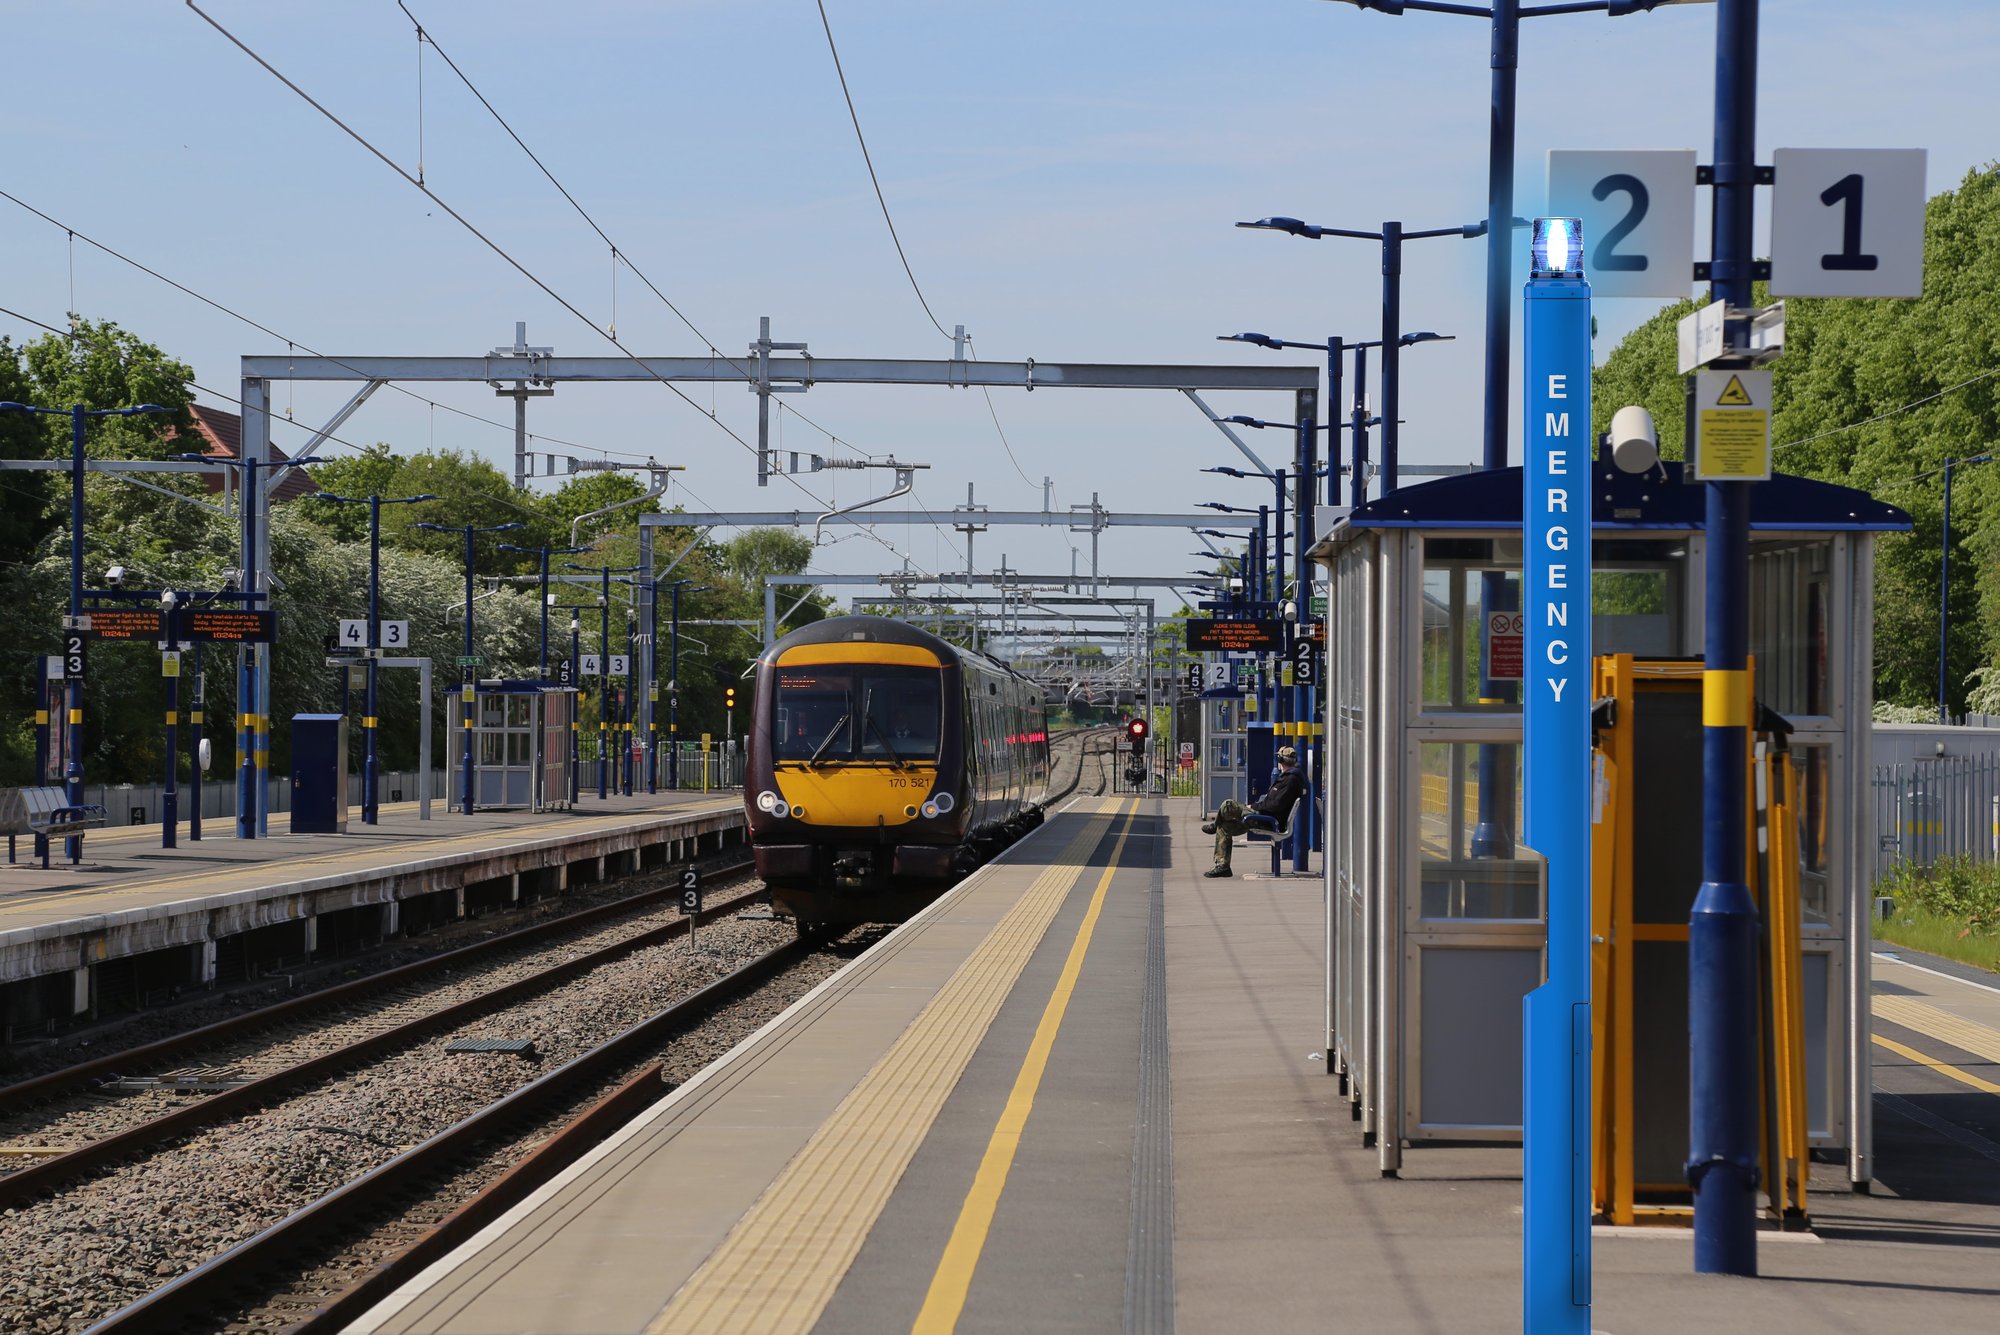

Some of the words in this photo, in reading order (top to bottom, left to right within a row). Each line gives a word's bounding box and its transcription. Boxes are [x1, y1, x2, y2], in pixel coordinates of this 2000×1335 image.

[1592, 174, 1649, 271] 2
[1820, 174, 1878, 271] 1
[1545, 375, 1569, 703] EMERGENCY
[347, 624, 360, 642] 4
[389, 625, 400, 643] 3
[69, 638, 81, 653] 2
[1299, 643, 1310, 659] 2
[69, 657, 81, 672] 3
[561, 660, 569, 670] 4
[586, 659, 595, 671] 4
[615, 659, 623, 671] 3
[1192, 666, 1200, 675] 4
[1298, 662, 1310, 677] 3
[561, 672, 568, 681] 5
[1216, 667, 1224, 679] 2
[1192, 677, 1199, 686] 5
[671, 698, 677, 706] 6
[889, 779, 906, 787] 170
[911, 779, 930, 787] 521
[134, 809, 142, 818] 4
[685, 873, 696, 888] 2
[685, 891, 696, 907] 3
